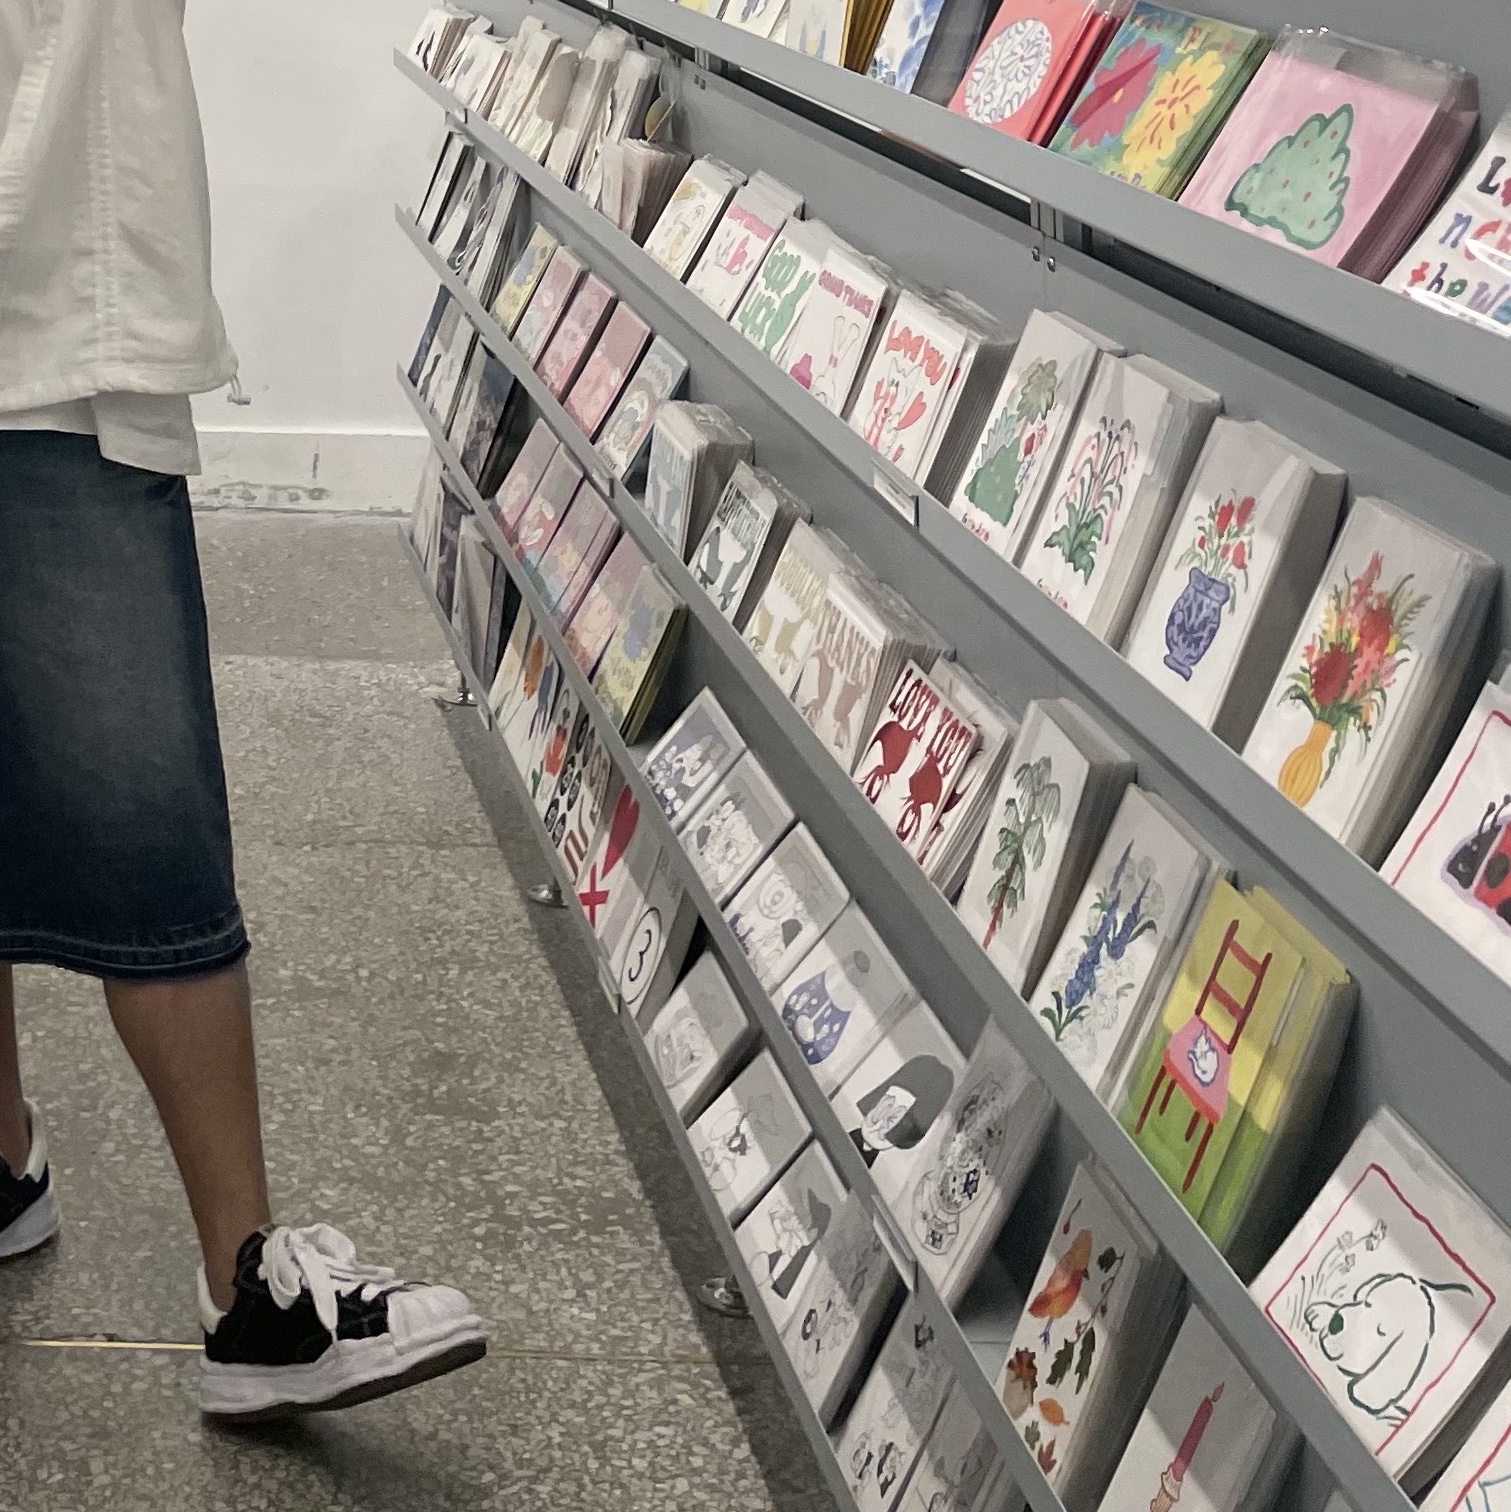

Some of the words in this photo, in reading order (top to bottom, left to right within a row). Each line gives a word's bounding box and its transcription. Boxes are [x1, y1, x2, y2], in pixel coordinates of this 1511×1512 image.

[921, 339, 948, 386] YOU
[889, 668, 941, 742] LOVE
[927, 705, 974, 776] YOU
